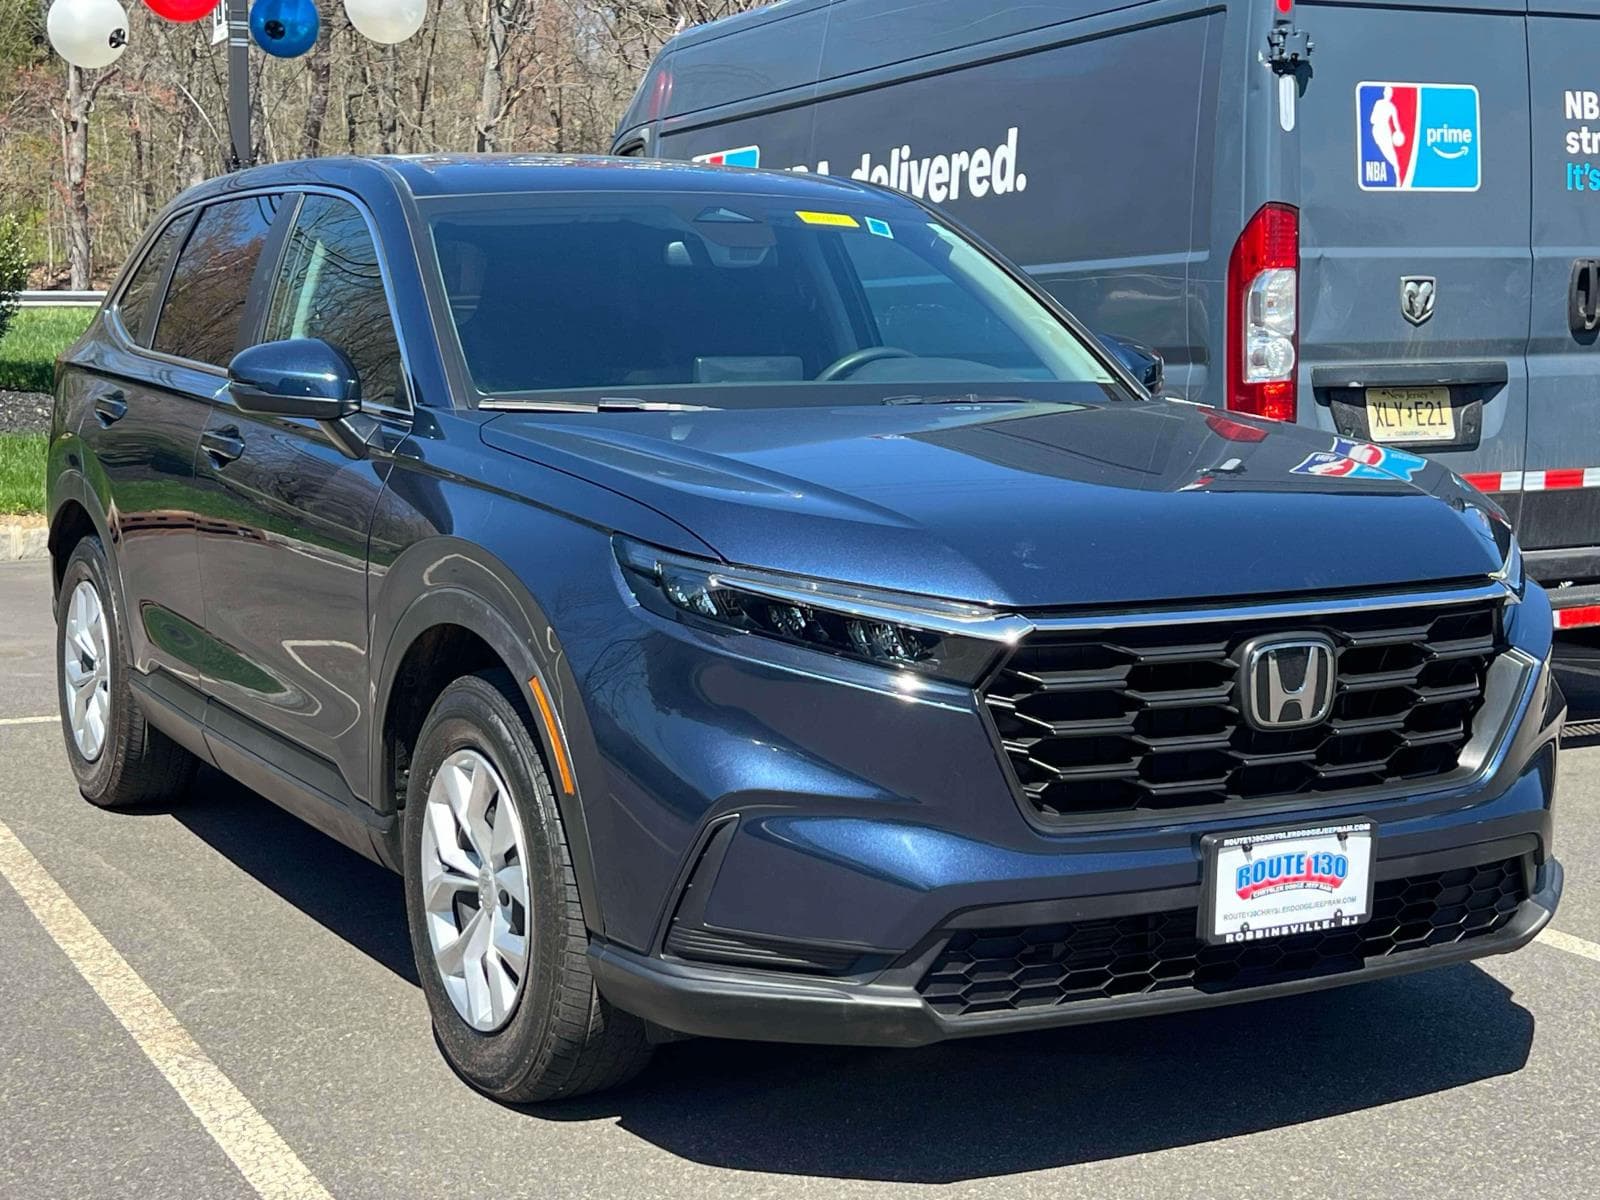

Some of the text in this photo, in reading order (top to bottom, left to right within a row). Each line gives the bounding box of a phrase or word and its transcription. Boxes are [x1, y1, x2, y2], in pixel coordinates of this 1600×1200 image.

[1564, 90, 1600, 120] NB
[1426, 123, 1473, 146] prime
[1366, 161, 1388, 182] NBA
[1236, 851, 1308, 890] ROUTE
[1312, 851, 1349, 879] 130
[1341, 916, 1359, 926] NJ
